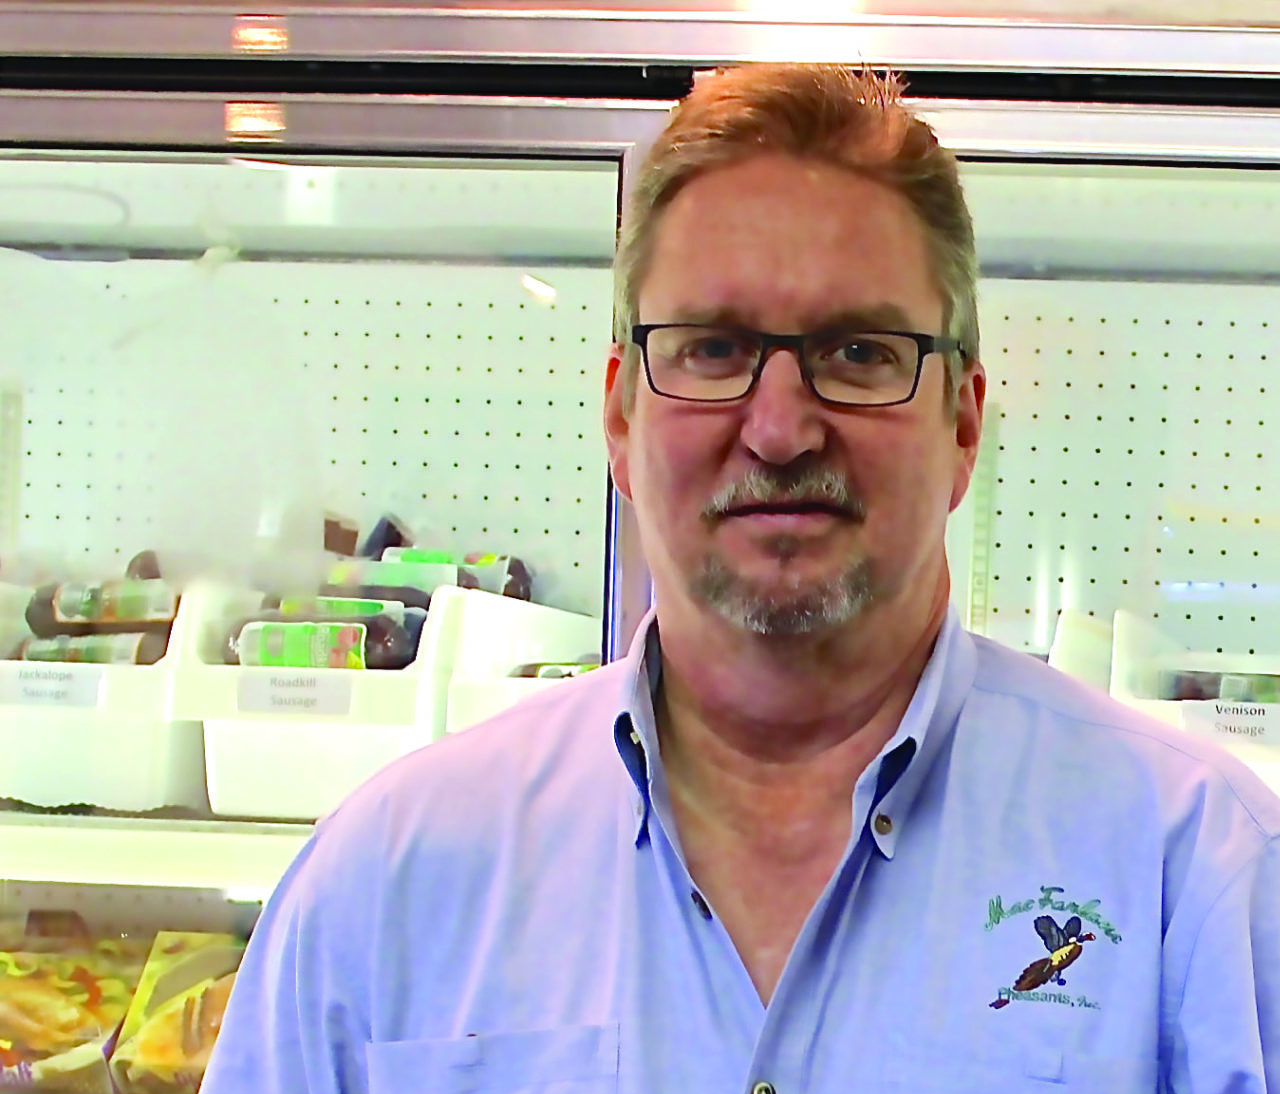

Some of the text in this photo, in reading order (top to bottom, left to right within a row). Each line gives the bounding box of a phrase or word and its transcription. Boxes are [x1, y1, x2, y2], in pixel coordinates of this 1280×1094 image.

[271, 695, 318, 708] Sausage
[1215, 703, 1266, 716] Venison
[1214, 722, 1266, 737] Sausage
